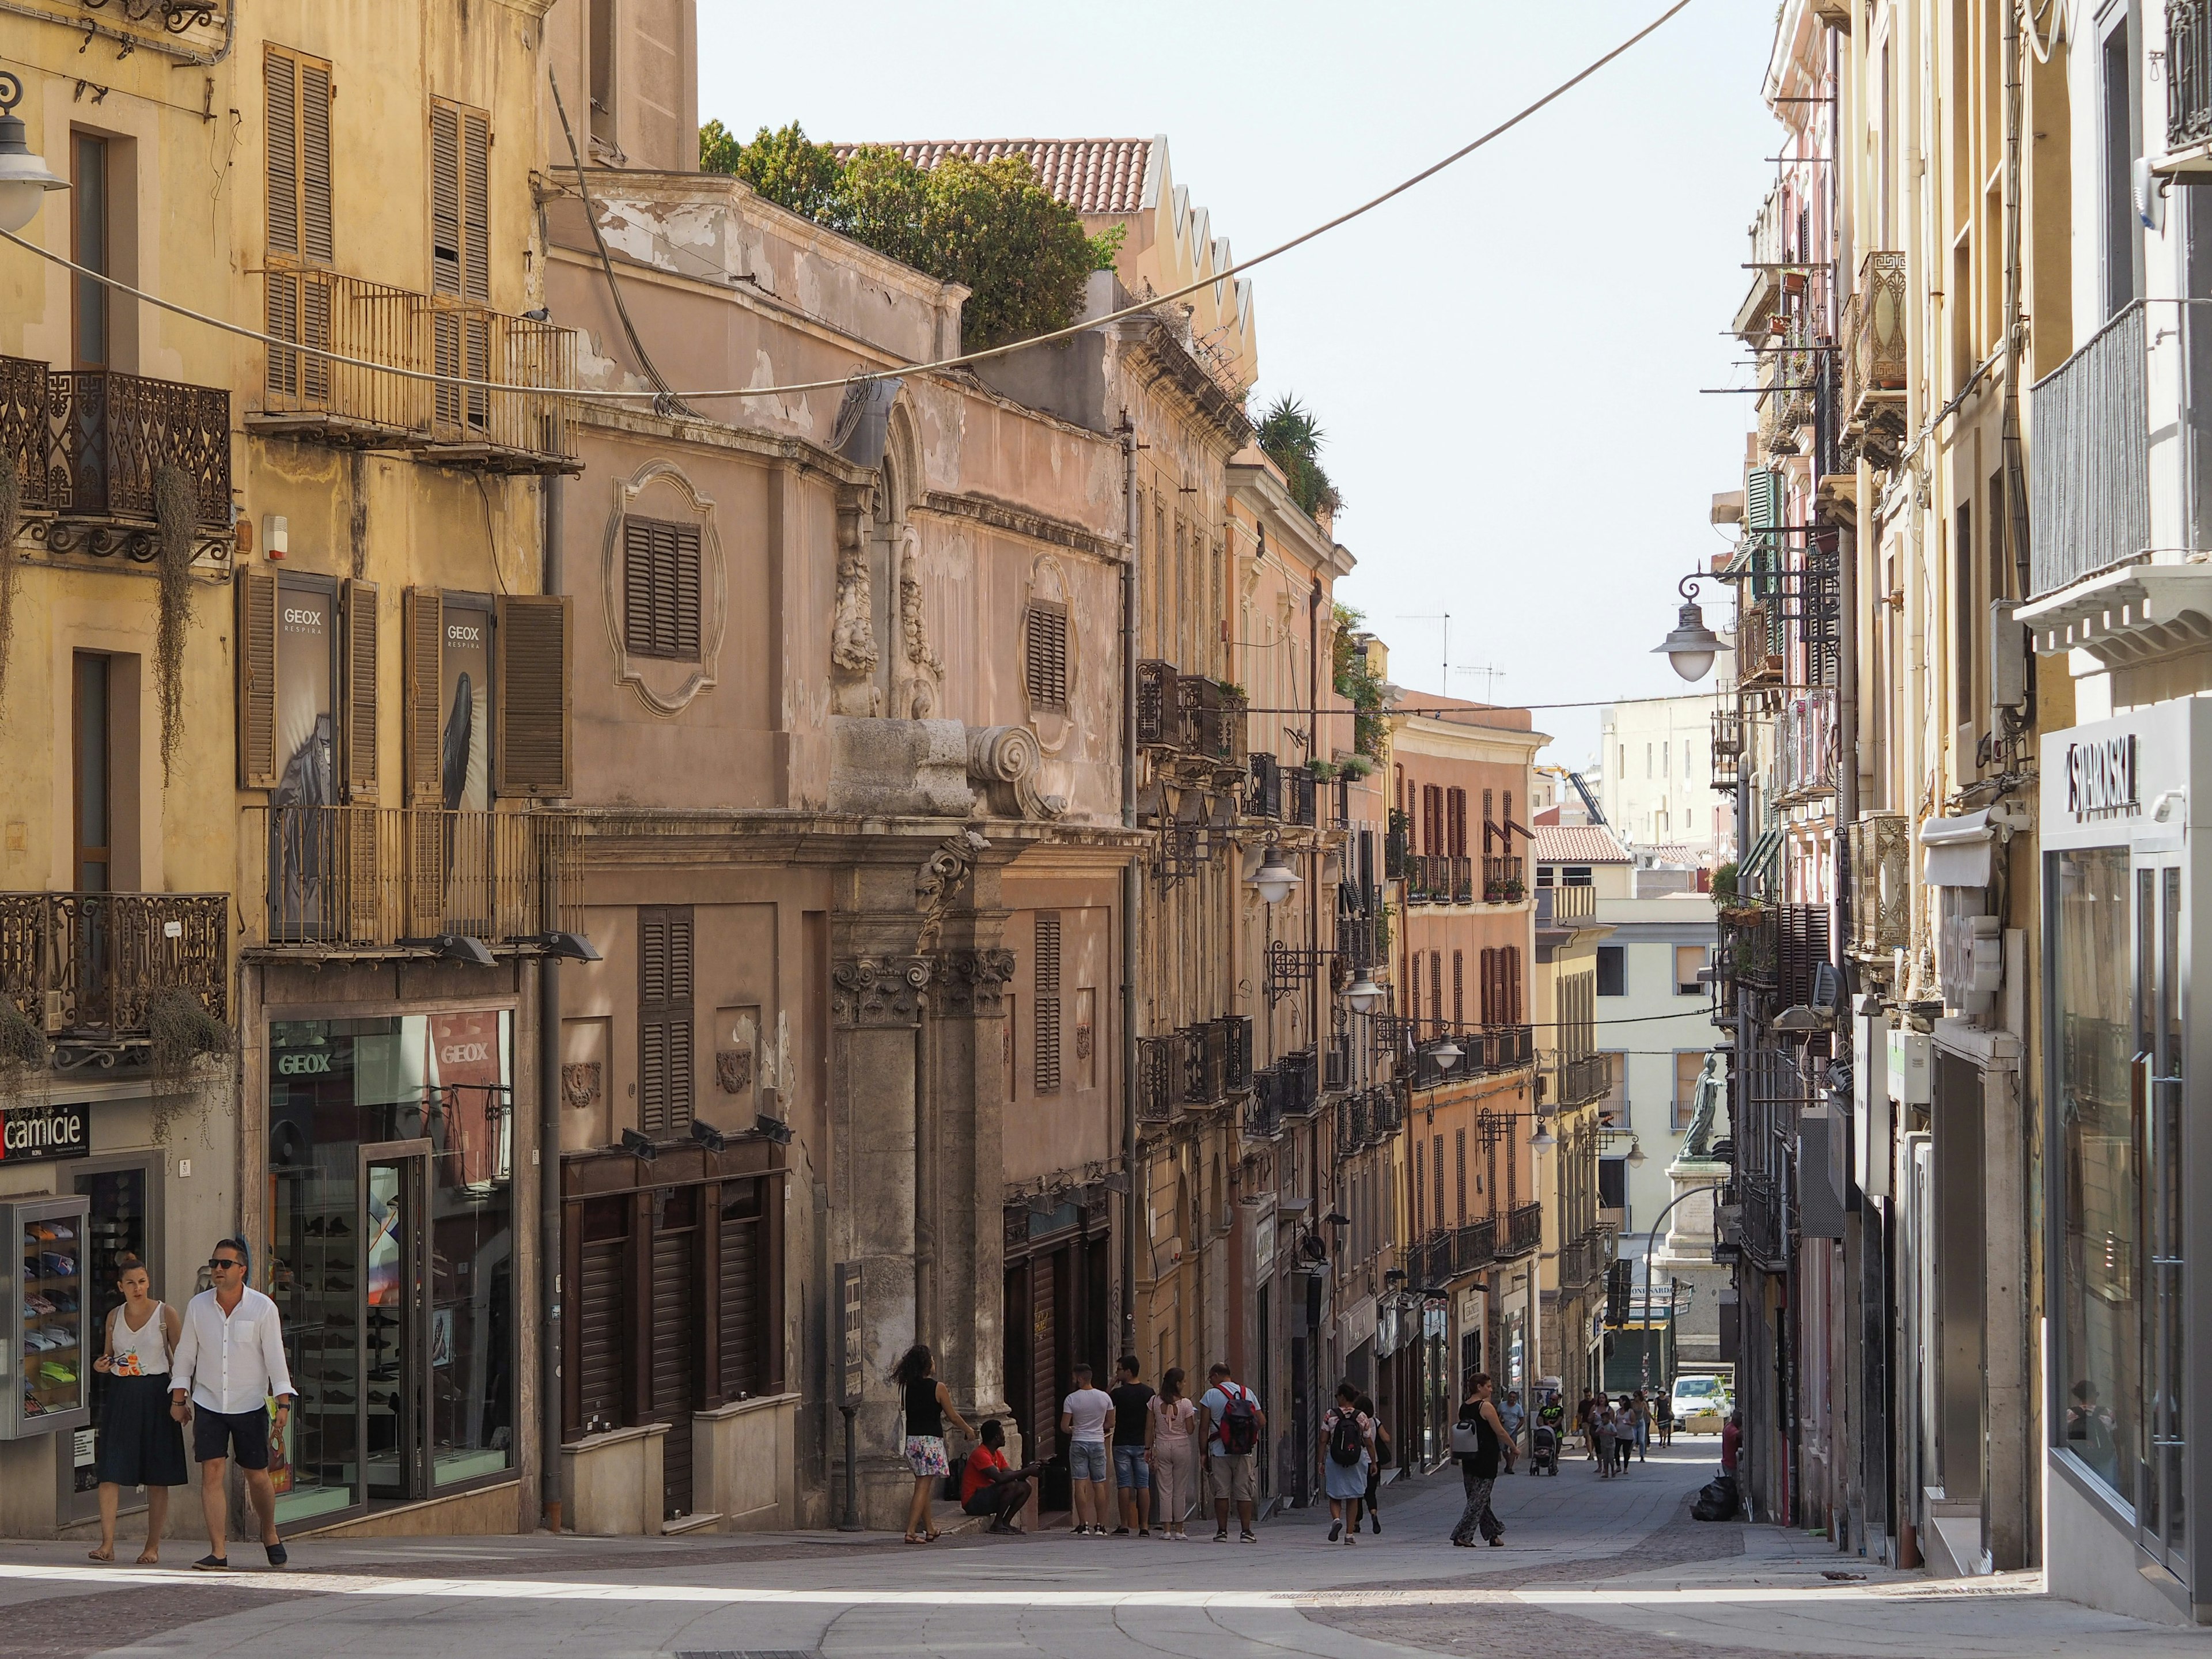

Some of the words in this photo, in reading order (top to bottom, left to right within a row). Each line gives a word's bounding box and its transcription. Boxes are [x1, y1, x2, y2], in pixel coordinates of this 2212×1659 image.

[285, 608, 321, 626] GEOX
[285, 626, 321, 634] RESPIRA
[448, 625, 479, 641] GEOX
[448, 641, 479, 649] RESPIRA
[2072, 734, 2130, 812] SWAROVSKI
[441, 1042, 488, 1064] GEOX
[279, 1054, 331, 1074] GEOX
[4, 1107, 81, 1149] camicie
[1543, 1407, 1560, 1417] 46
